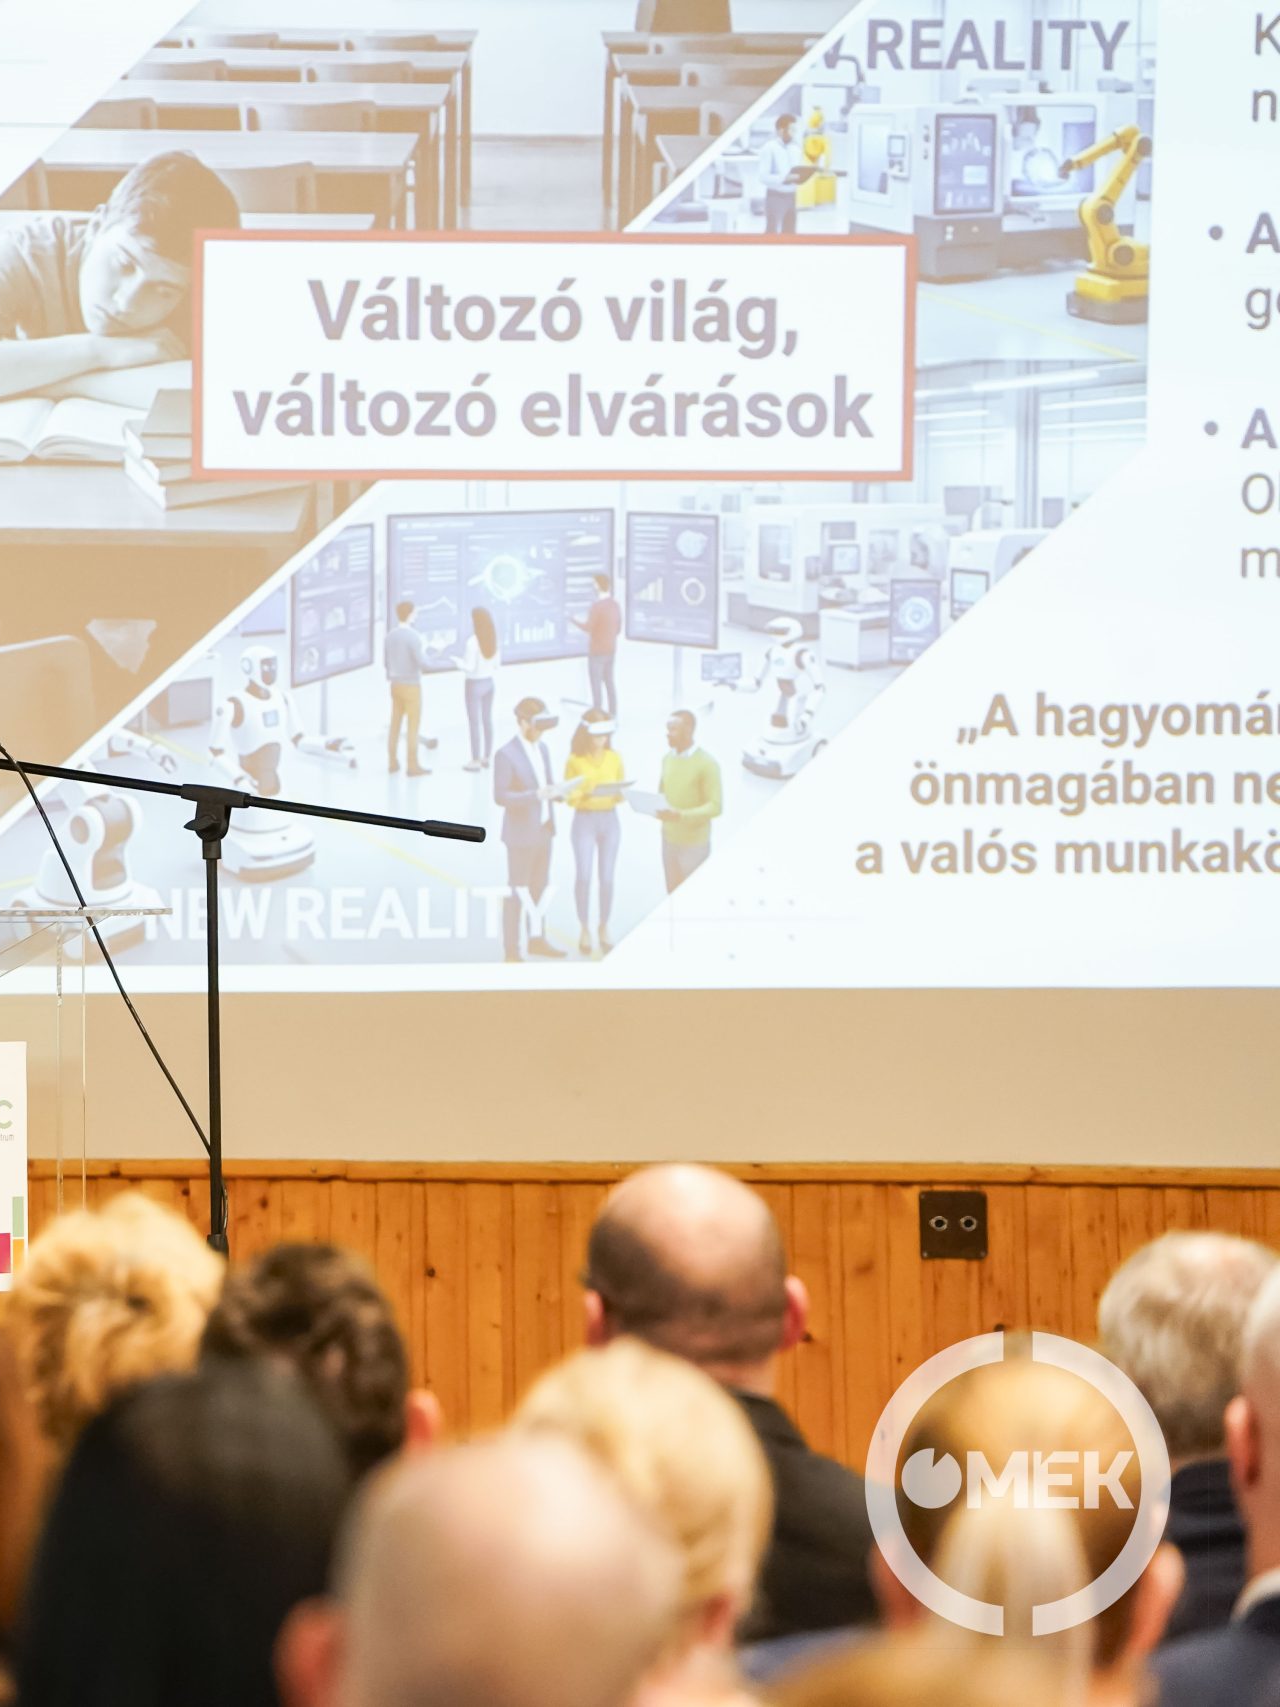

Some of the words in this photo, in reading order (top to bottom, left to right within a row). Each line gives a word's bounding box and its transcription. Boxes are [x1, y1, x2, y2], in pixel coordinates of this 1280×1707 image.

[865, 18, 1129, 72] REALITY
[307, 276, 583, 342] Változó
[604, 278, 799, 360] világ,
[1245, 287, 1280, 332] g
[232, 371, 497, 438] változó
[520, 372, 874, 438] elvárások
[1240, 472, 1280, 516] O
[1035, 688, 1280, 750] hagyomá
[909, 758, 1216, 818] önmagában
[854, 840, 884, 876] a
[900, 827, 1038, 876] valós
[145, 887, 272, 940] NEW
[286, 886, 557, 940] REALITY
